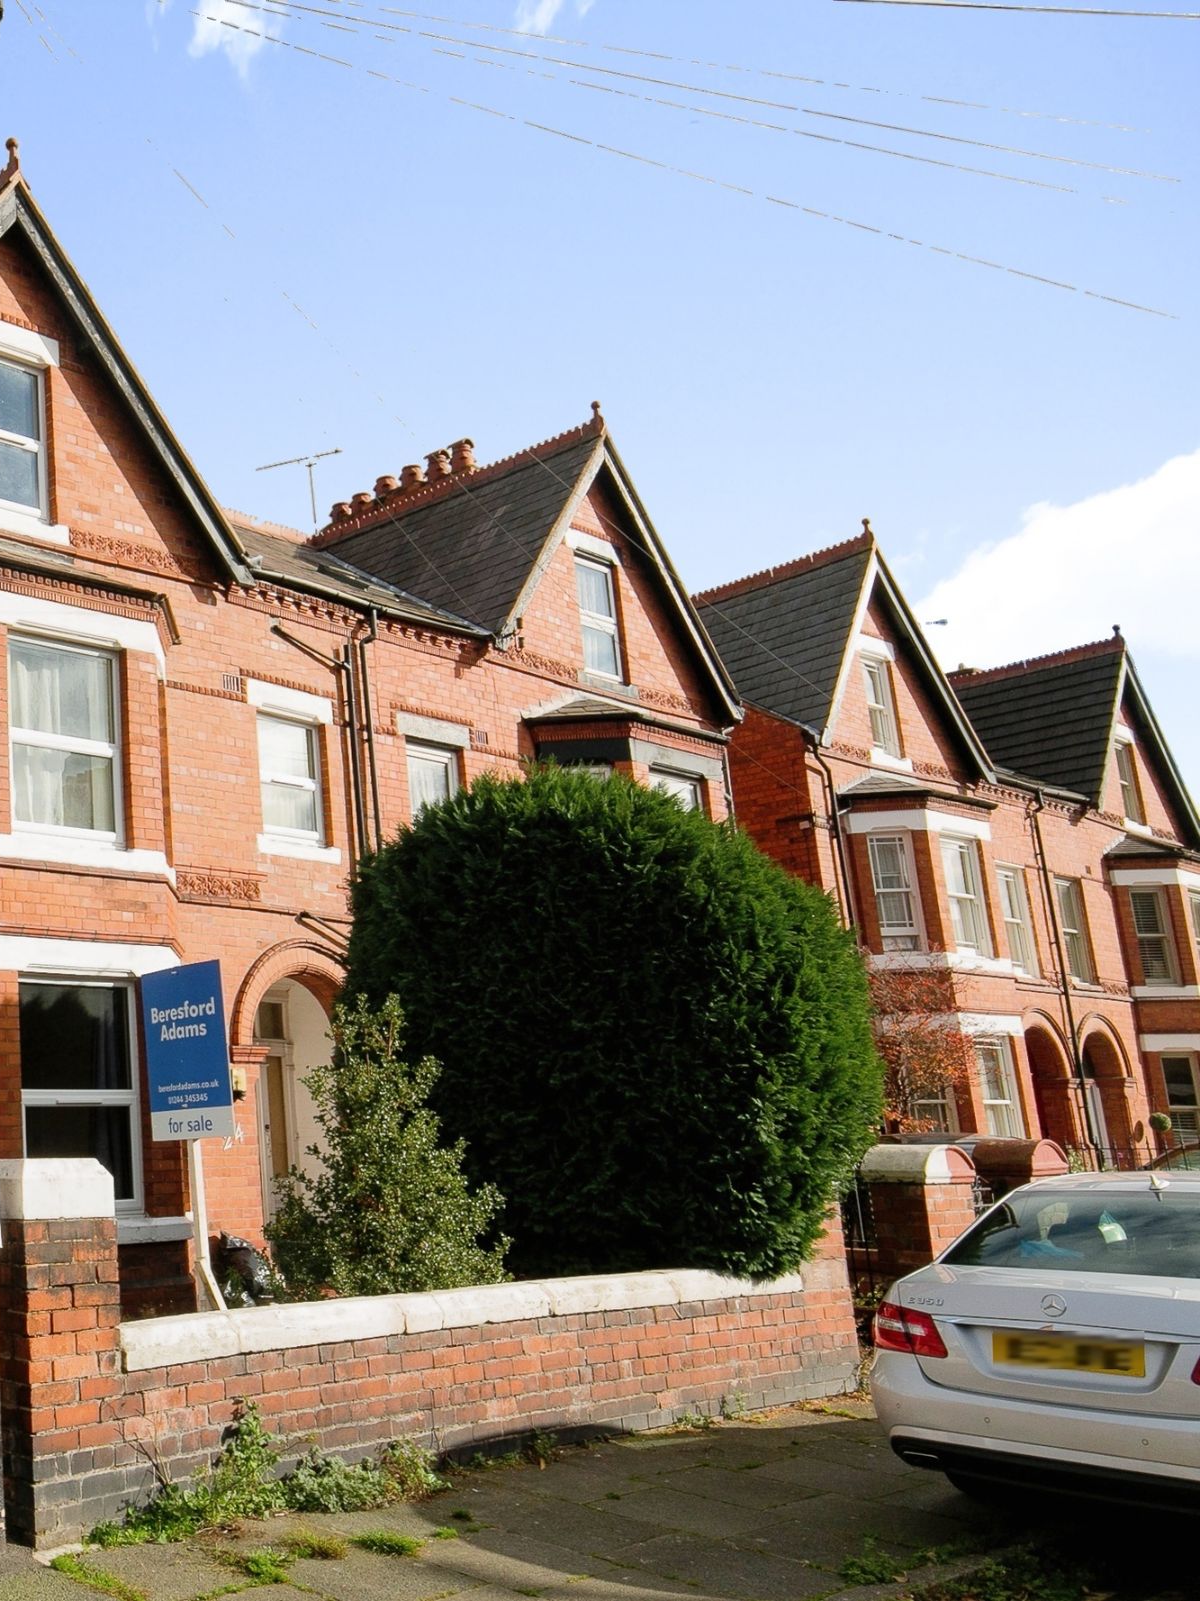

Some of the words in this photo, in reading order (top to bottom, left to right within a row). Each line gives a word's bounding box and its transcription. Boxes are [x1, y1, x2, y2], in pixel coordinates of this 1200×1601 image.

[151, 997, 215, 1024] Beresford
[160, 1022, 207, 1041] Adams
[158, 1079, 219, 1093] beresfordadams.co.uk
[184, 1093, 208, 1103] 345345
[168, 1117, 183, 1133] for
[187, 1115, 213, 1132] sale
